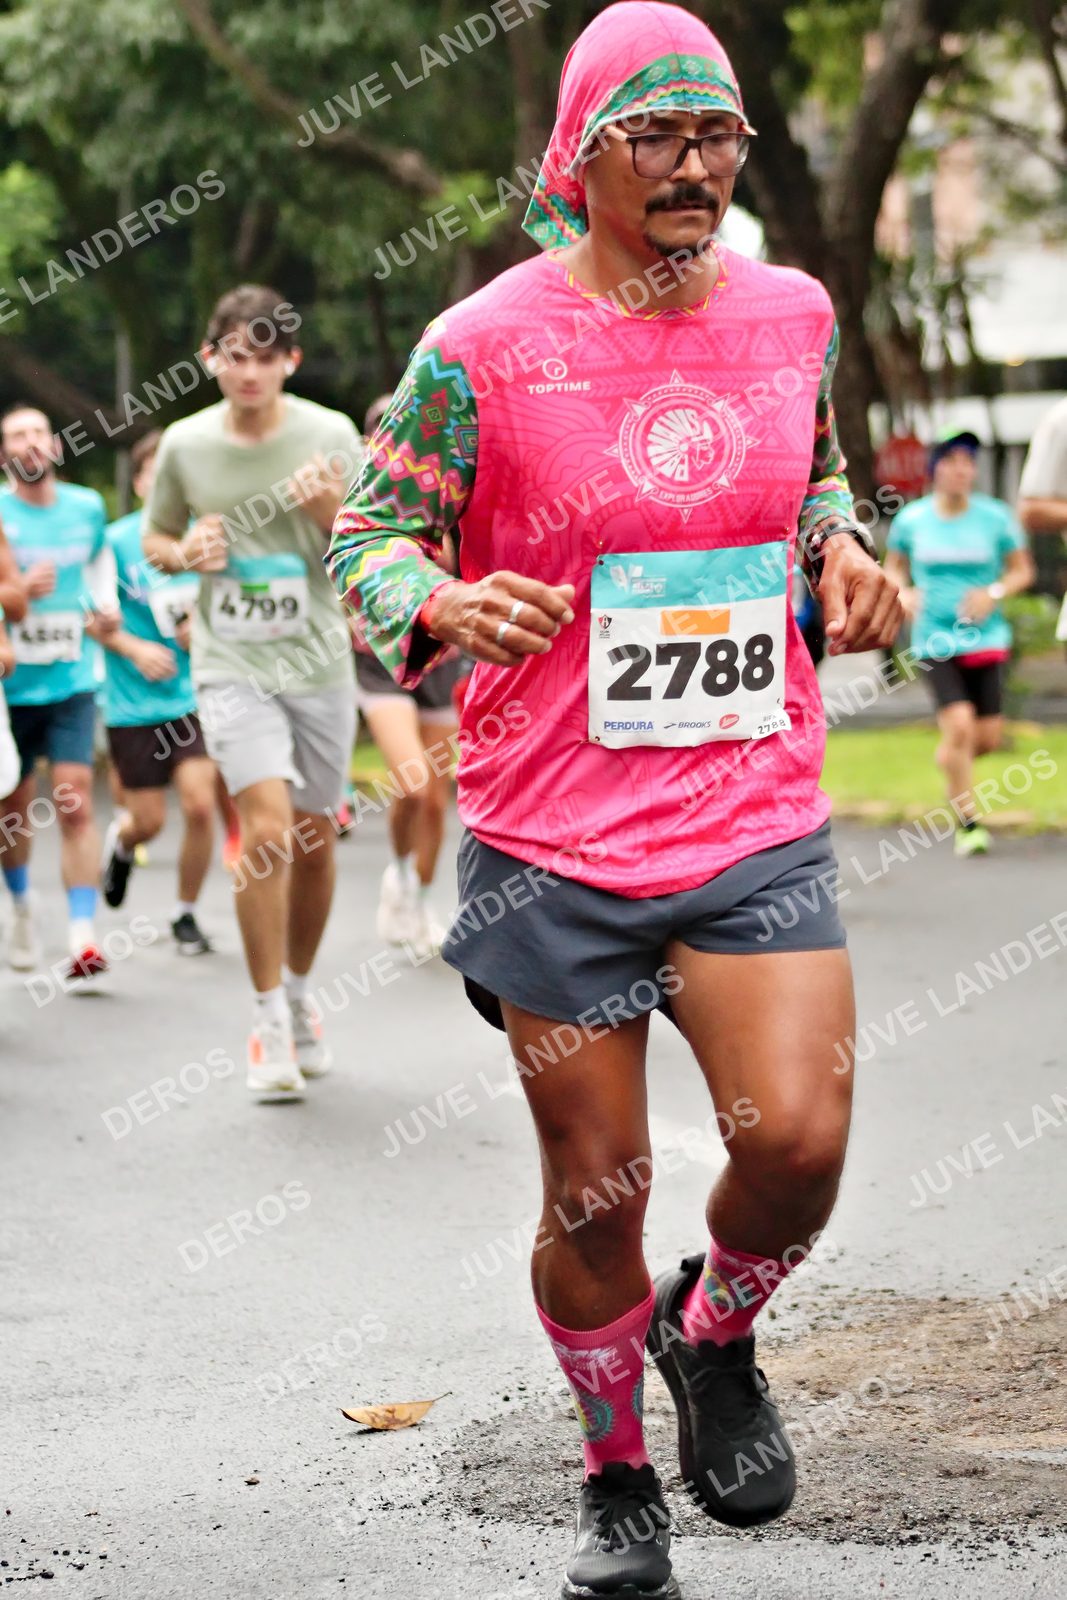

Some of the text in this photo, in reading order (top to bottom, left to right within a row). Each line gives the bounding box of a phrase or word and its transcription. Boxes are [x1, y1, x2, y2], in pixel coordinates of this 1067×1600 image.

[527, 381, 591, 395] TOPTIME
[220, 592, 299, 621] 4799
[606, 633, 775, 701] 2788
[603, 720, 654, 731] PERDURA
[678, 720, 711, 729] BROOKS
[758, 719, 786, 735] 2788
